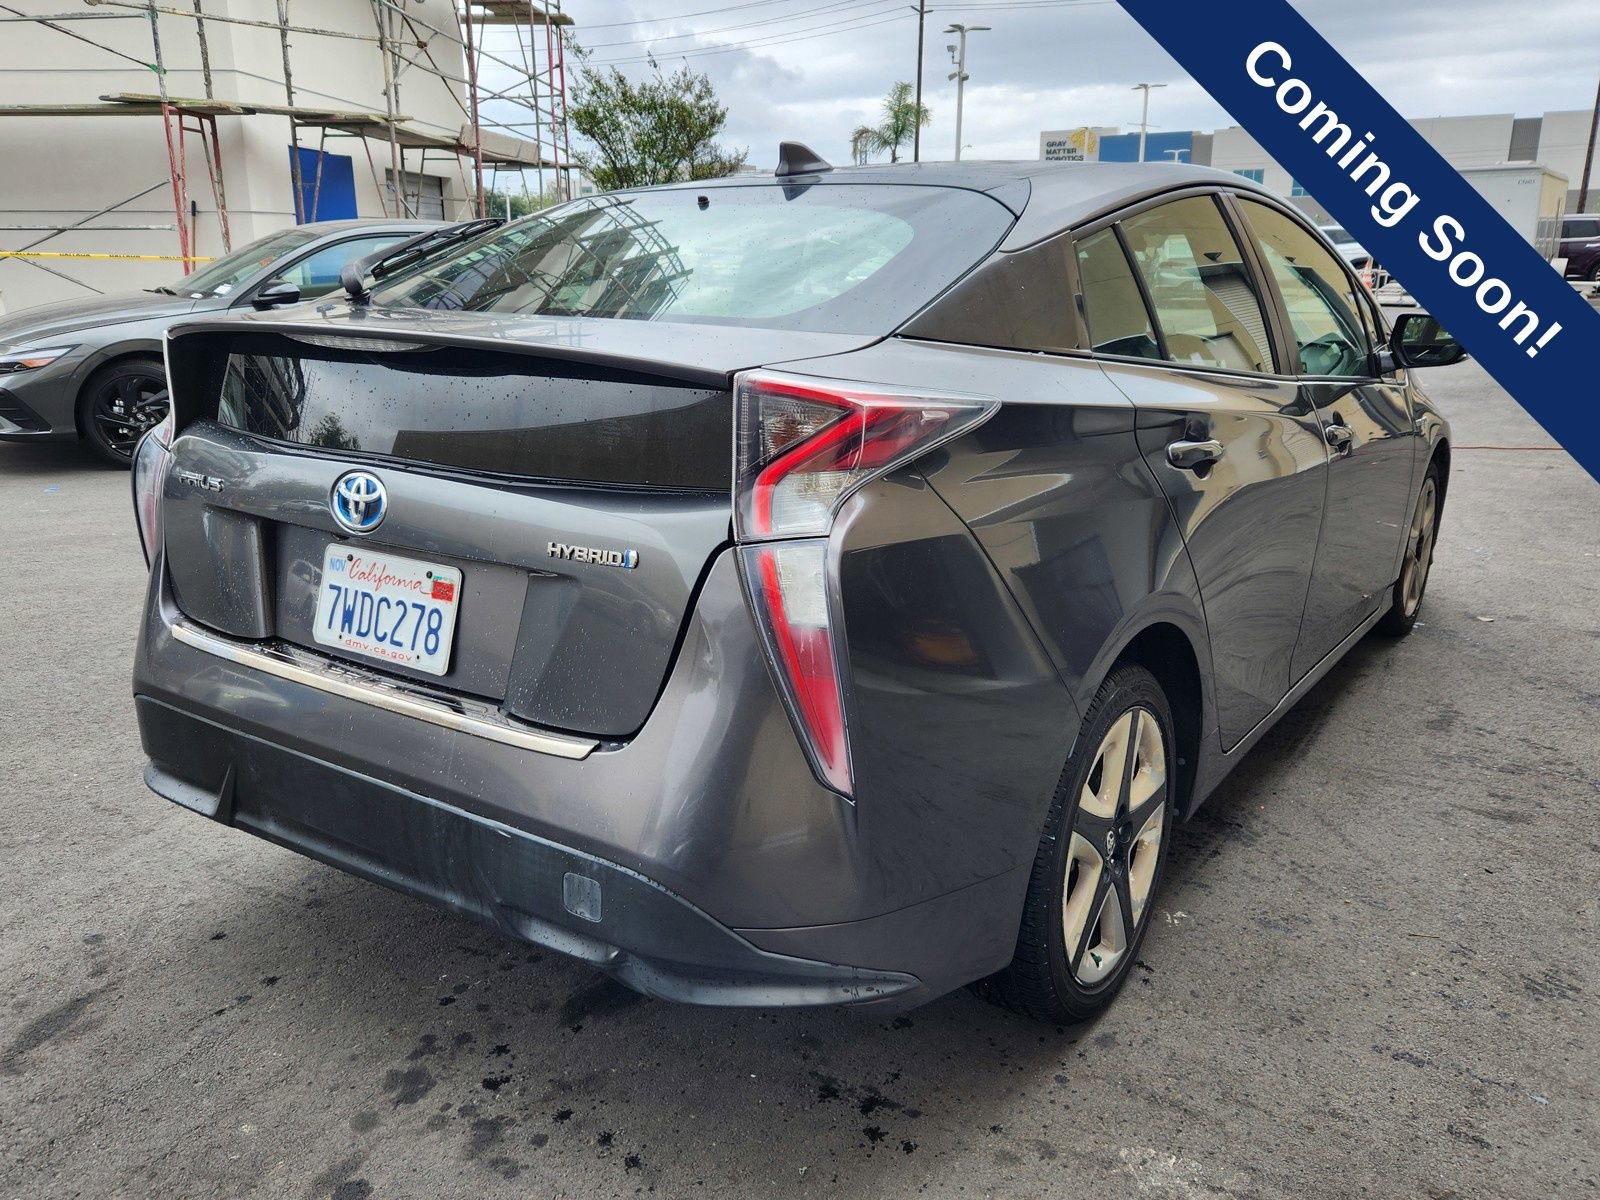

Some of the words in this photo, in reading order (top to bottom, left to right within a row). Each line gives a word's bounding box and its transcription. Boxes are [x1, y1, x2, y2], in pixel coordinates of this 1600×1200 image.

[1046, 140, 1067, 148] GRAY
[330, 557, 347, 573] NOV
[547, 542, 622, 567] HYBRID
[349, 557, 432, 592] California
[328, 583, 443, 656] 7WDC278
[345, 638, 412, 662] dmv.ca.gov
